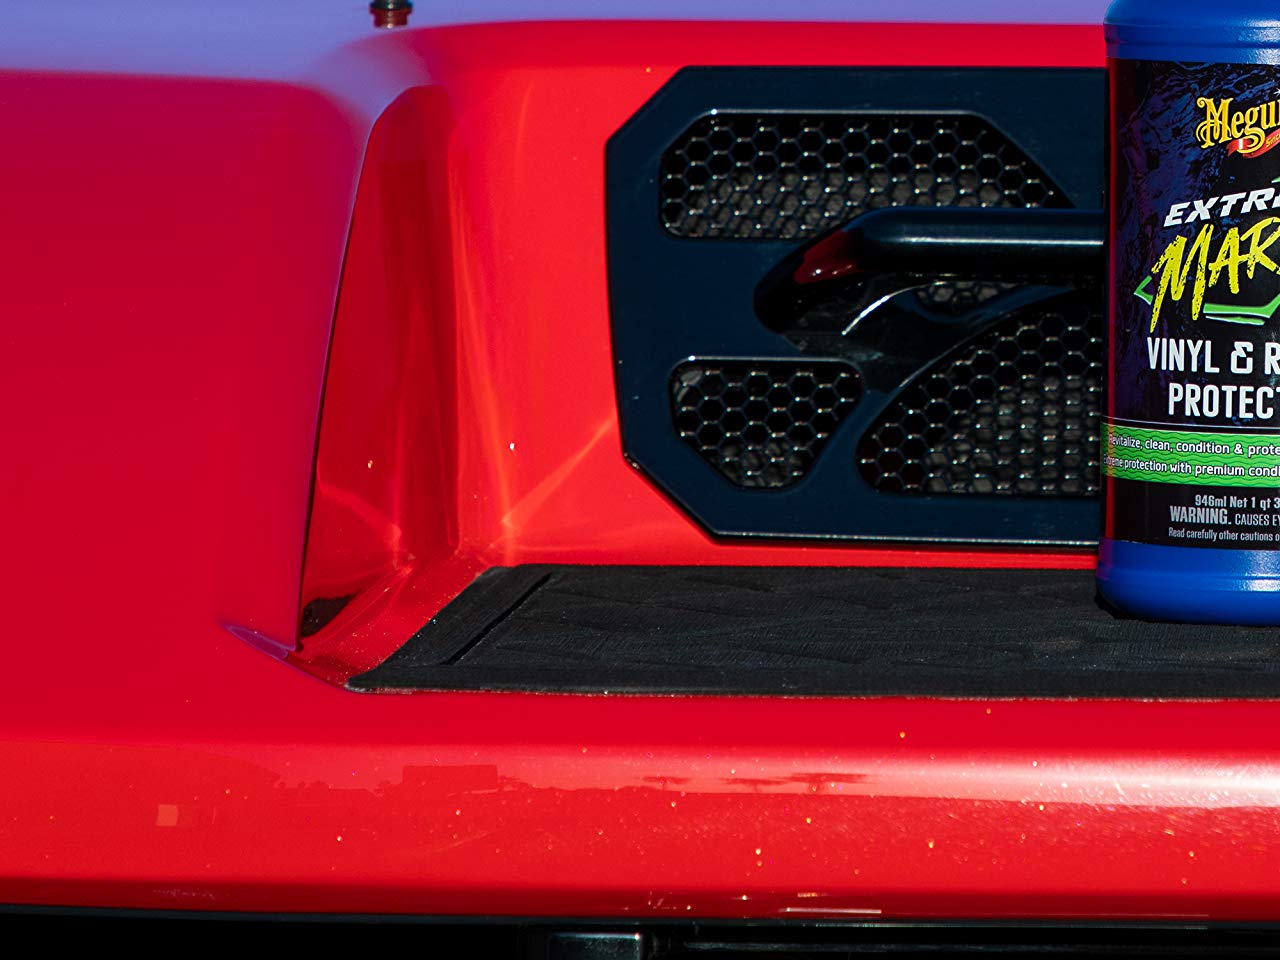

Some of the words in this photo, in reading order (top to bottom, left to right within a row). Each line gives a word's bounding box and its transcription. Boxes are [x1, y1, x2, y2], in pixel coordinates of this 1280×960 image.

[1147, 337, 1220, 373] VINYL
[1230, 341, 1253, 374] &
[1144, 439, 1173, 453] clean,
[1176, 441, 1230, 454] condition
[1233, 443, 1244, 455] &
[1124, 458, 1167, 472] protection
[1170, 461, 1192, 474] with
[1195, 464, 1245, 477] premium
[1195, 494, 1227, 508] 946ml
[1229, 496, 1248, 508] Net
[1251, 496, 1256, 509] 1
[1260, 498, 1272, 511] qt
[1169, 505, 1232, 526] WARNING.
[1234, 513, 1270, 526] CAUSES
[1168, 527, 1185, 538] Read
[1186, 528, 1217, 542] carefully
[1219, 530, 1239, 541] other
[1240, 531, 1273, 542] cautions
